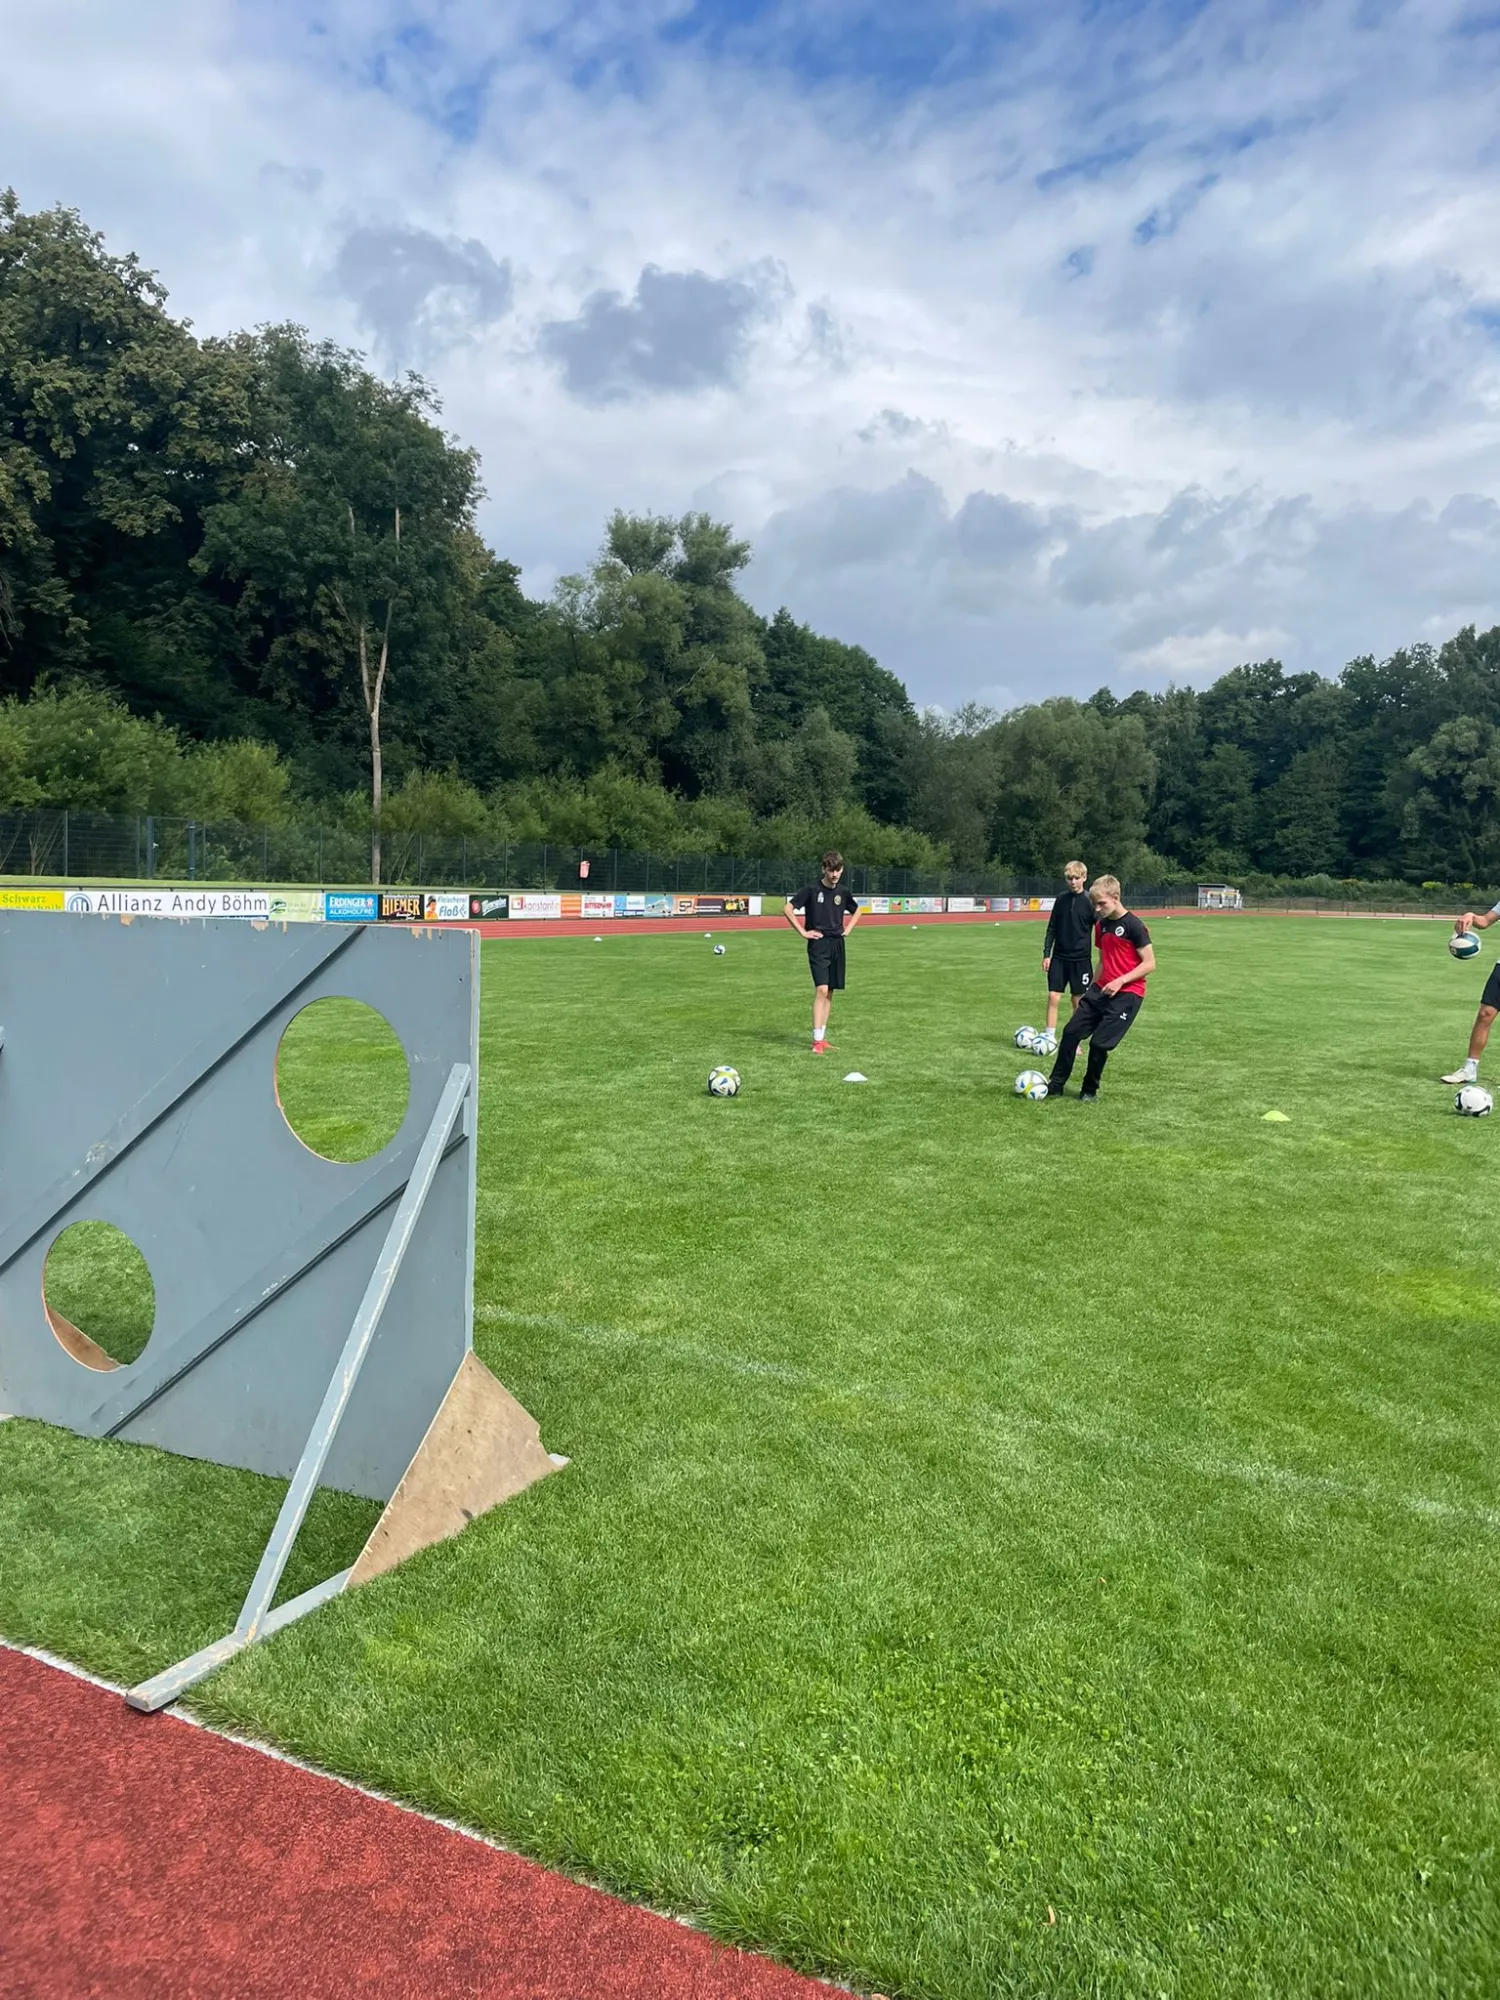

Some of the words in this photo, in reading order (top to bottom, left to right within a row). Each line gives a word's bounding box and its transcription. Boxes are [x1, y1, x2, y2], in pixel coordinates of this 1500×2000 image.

[2, 893, 47, 904] Schwarz
[98, 893, 162, 912] Allianz
[172, 894, 216, 914] Andy
[222, 894, 268, 912] Böhm
[329, 896, 366, 908] ERDINGER
[382, 898, 420, 916] HIEMER
[438, 905, 459, 917] Floß
[1082, 973, 1090, 985] 5
